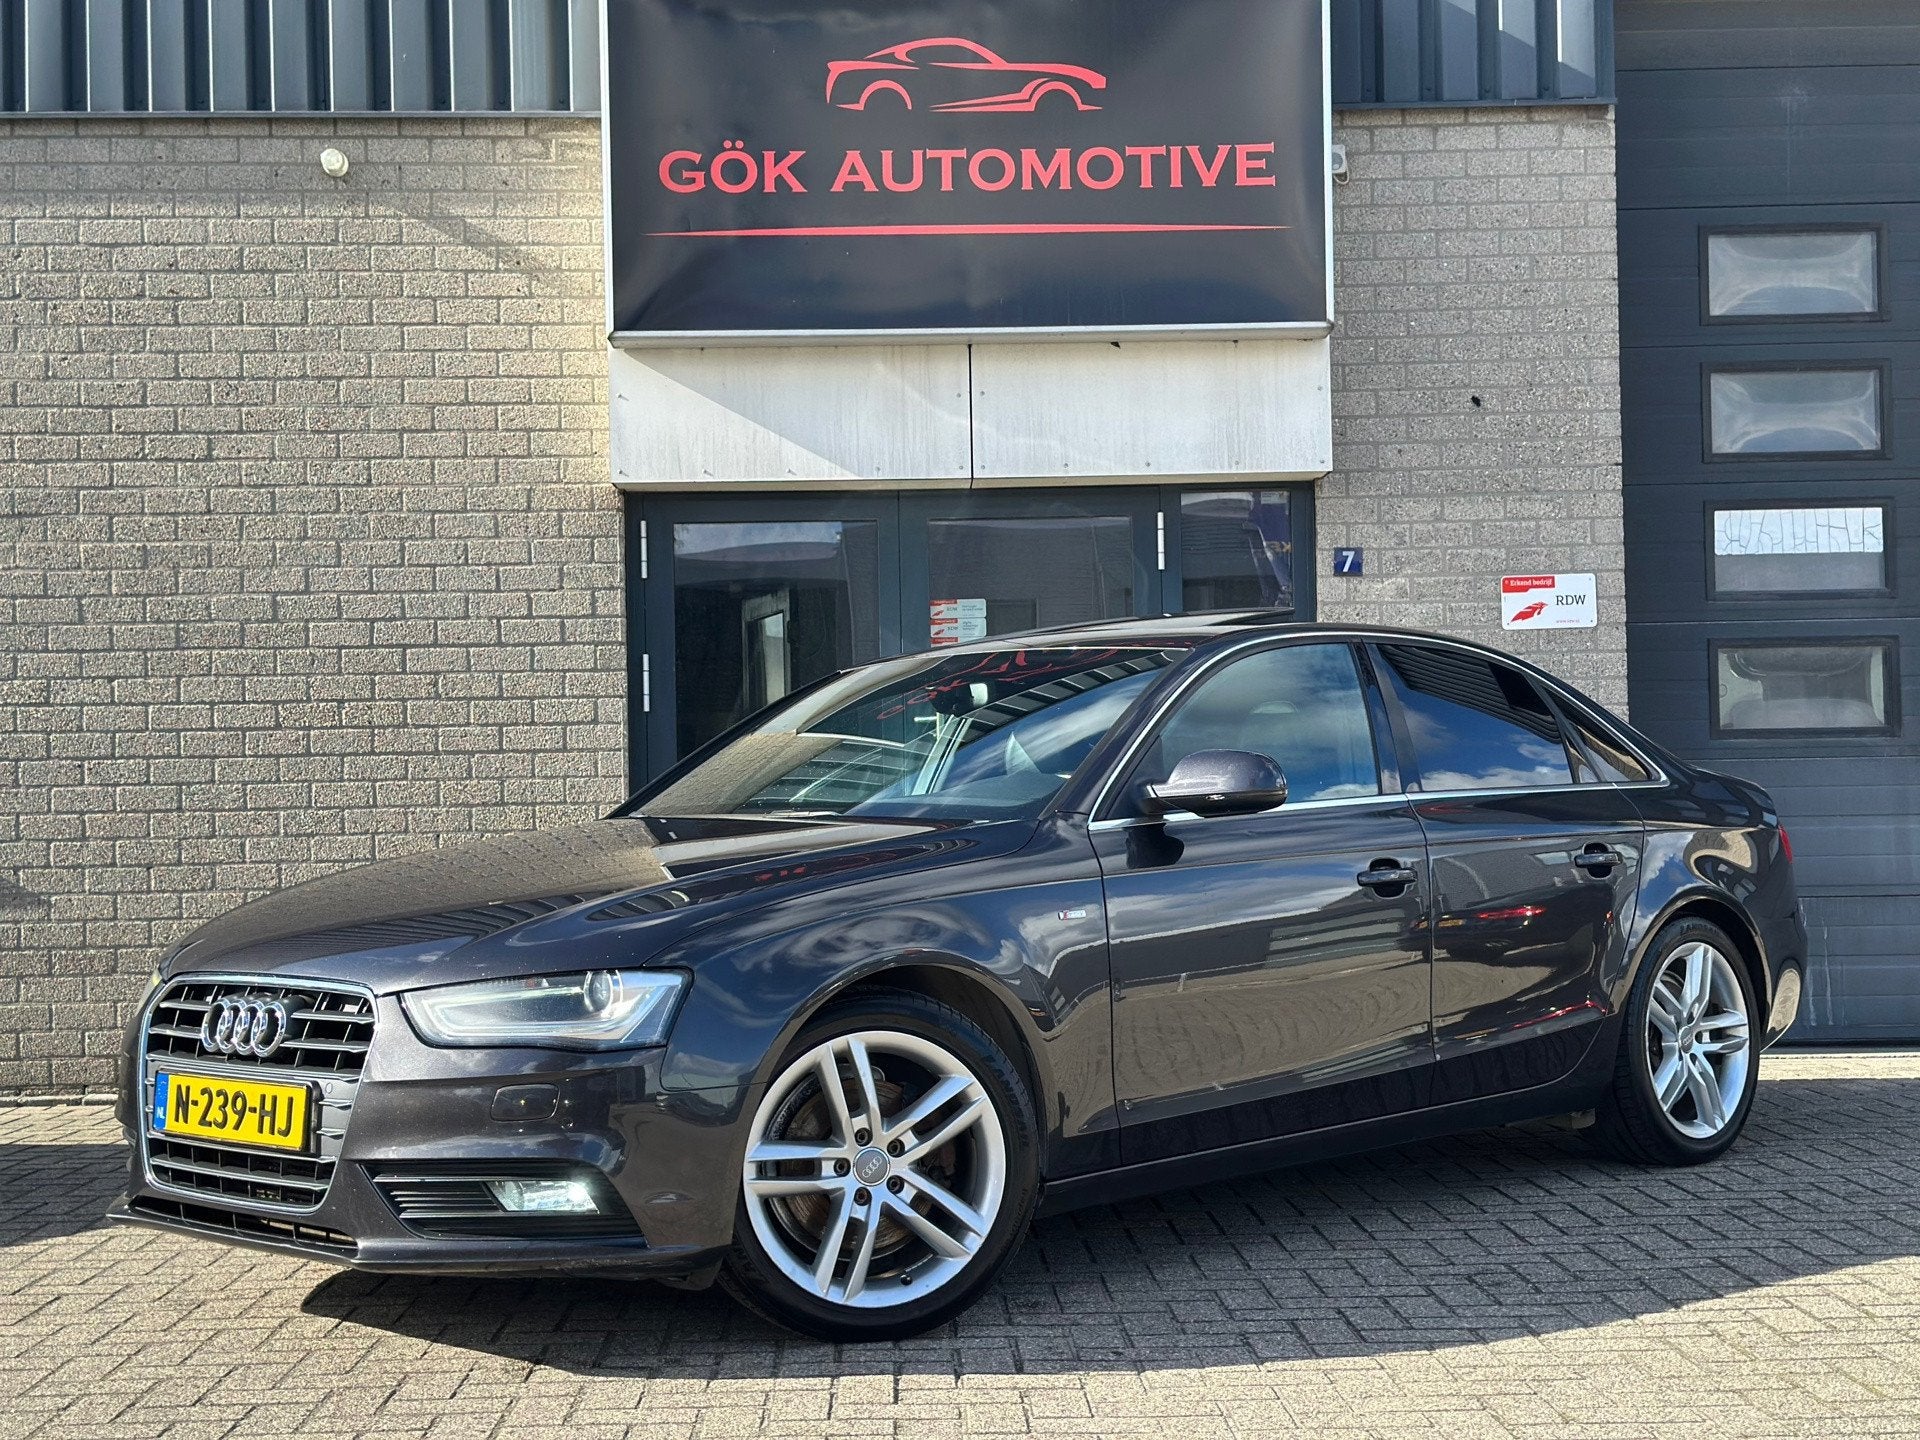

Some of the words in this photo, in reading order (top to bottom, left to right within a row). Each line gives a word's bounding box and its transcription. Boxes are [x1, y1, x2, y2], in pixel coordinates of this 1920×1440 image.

[659, 140, 808, 193] GÖK
[831, 142, 1276, 193] AUTOMOTIVE
[1342, 551, 1355, 572] 7
[1556, 595, 1586, 605] RDW
[174, 1084, 295, 1137] N-239-HJ
